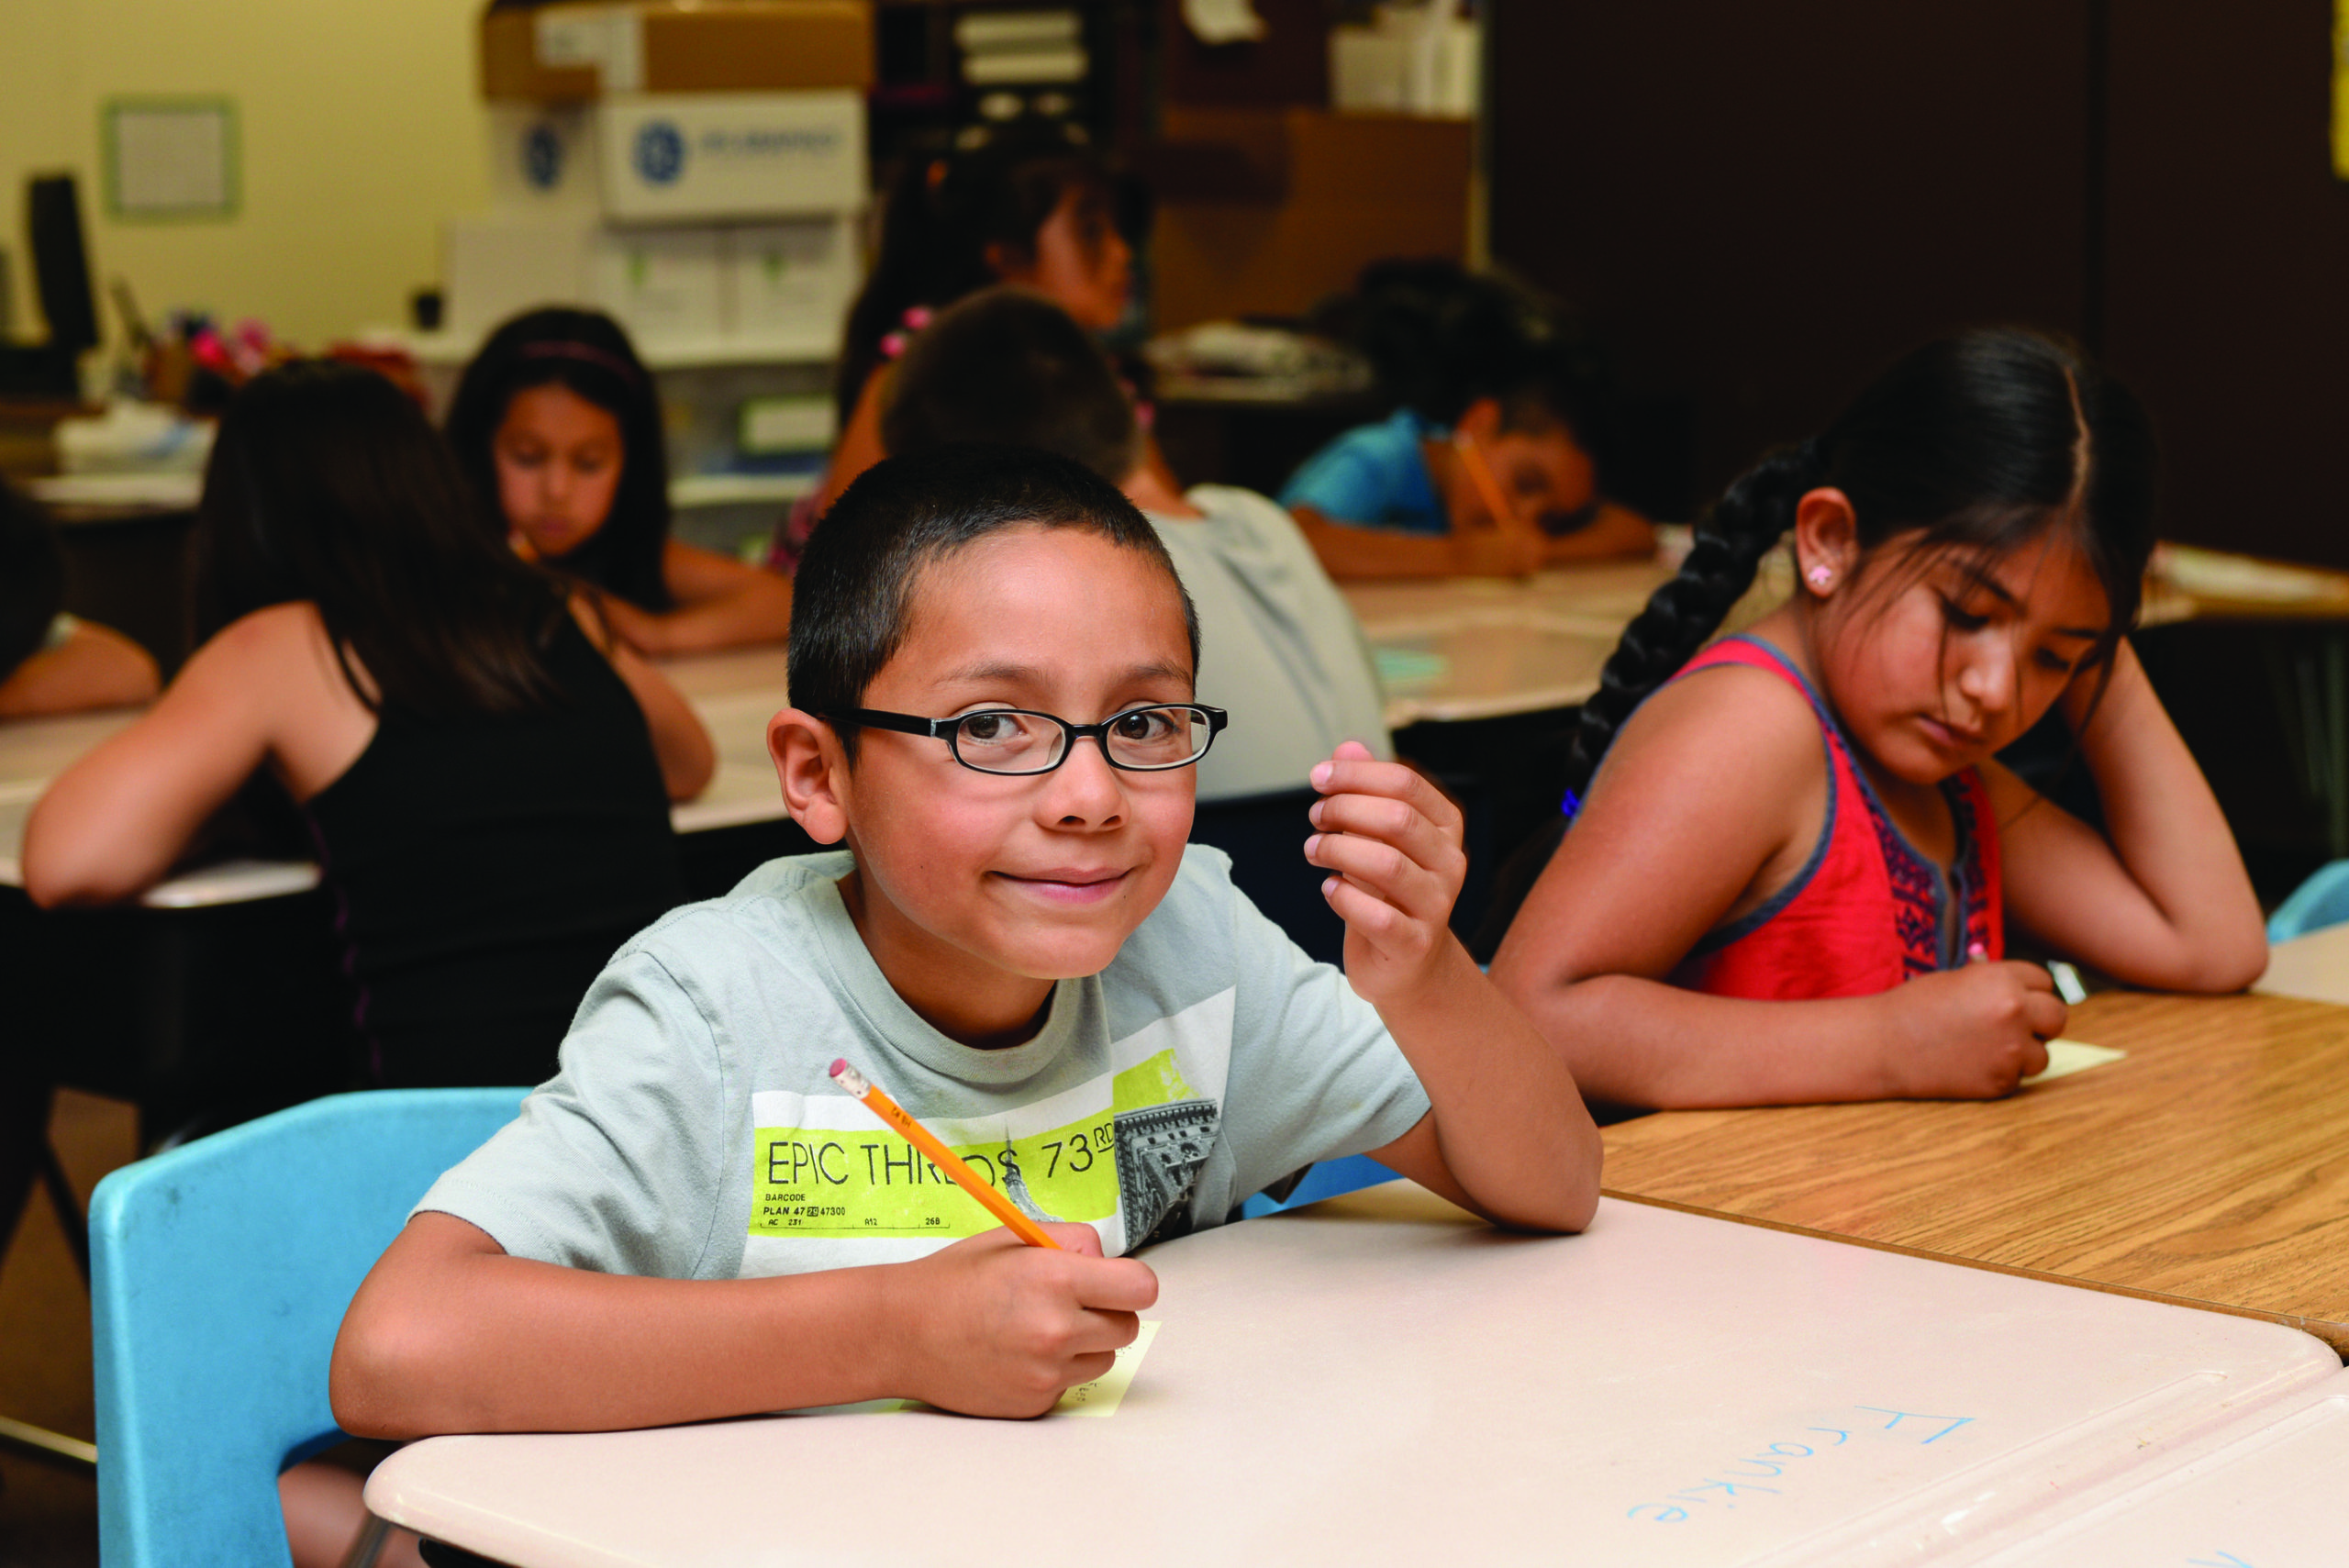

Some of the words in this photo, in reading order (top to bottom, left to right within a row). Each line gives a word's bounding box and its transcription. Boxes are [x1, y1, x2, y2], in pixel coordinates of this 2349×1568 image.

[768, 1141, 849, 1184] EPIC
[765, 1194, 806, 1202] BARCODE
[763, 1207, 790, 1216] PLAN
[793, 1207, 806, 1216] 47
[820, 1207, 846, 1216] 47300
[1626, 1405, 1976, 1523] Frankie
